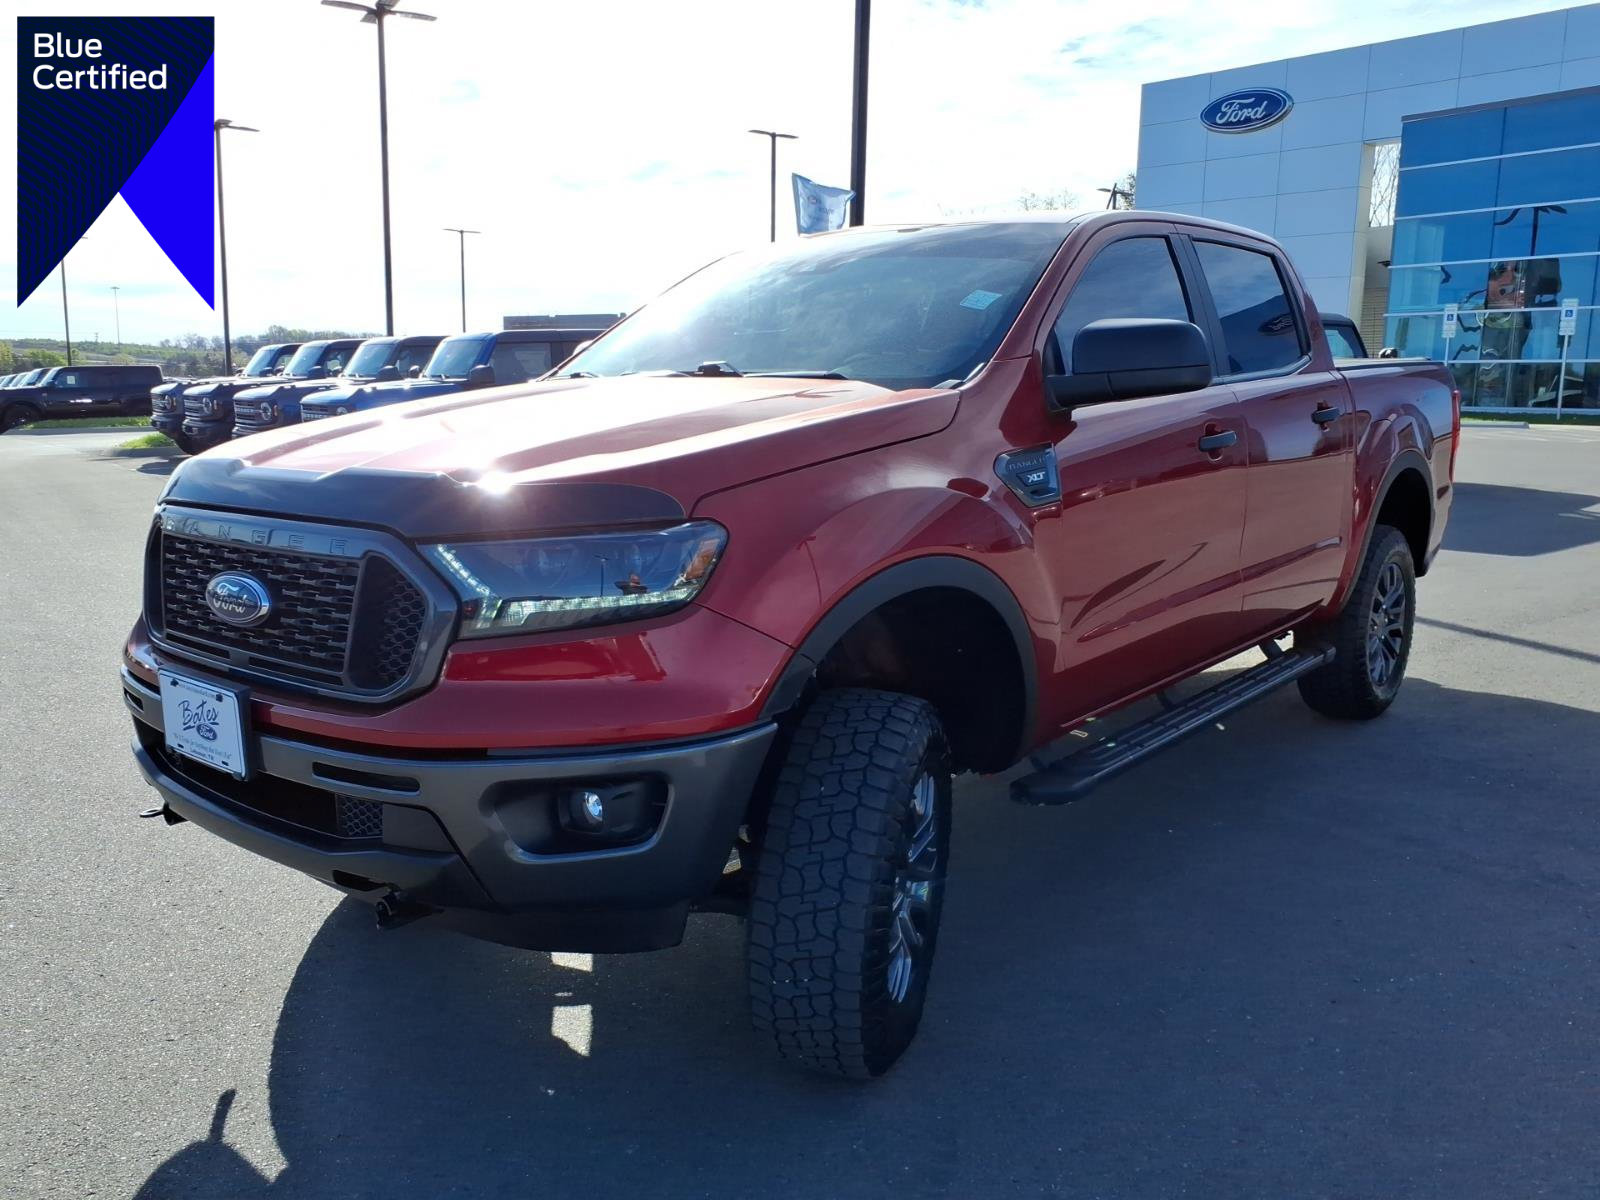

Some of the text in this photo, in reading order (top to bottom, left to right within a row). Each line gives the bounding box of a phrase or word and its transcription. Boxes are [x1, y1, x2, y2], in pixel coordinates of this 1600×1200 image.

[1215, 97, 1268, 124] Ford
[1026, 471, 1046, 483] XLT
[165, 515, 348, 555] RANGER
[211, 581, 249, 614] Ford
[178, 699, 219, 727] Bates
